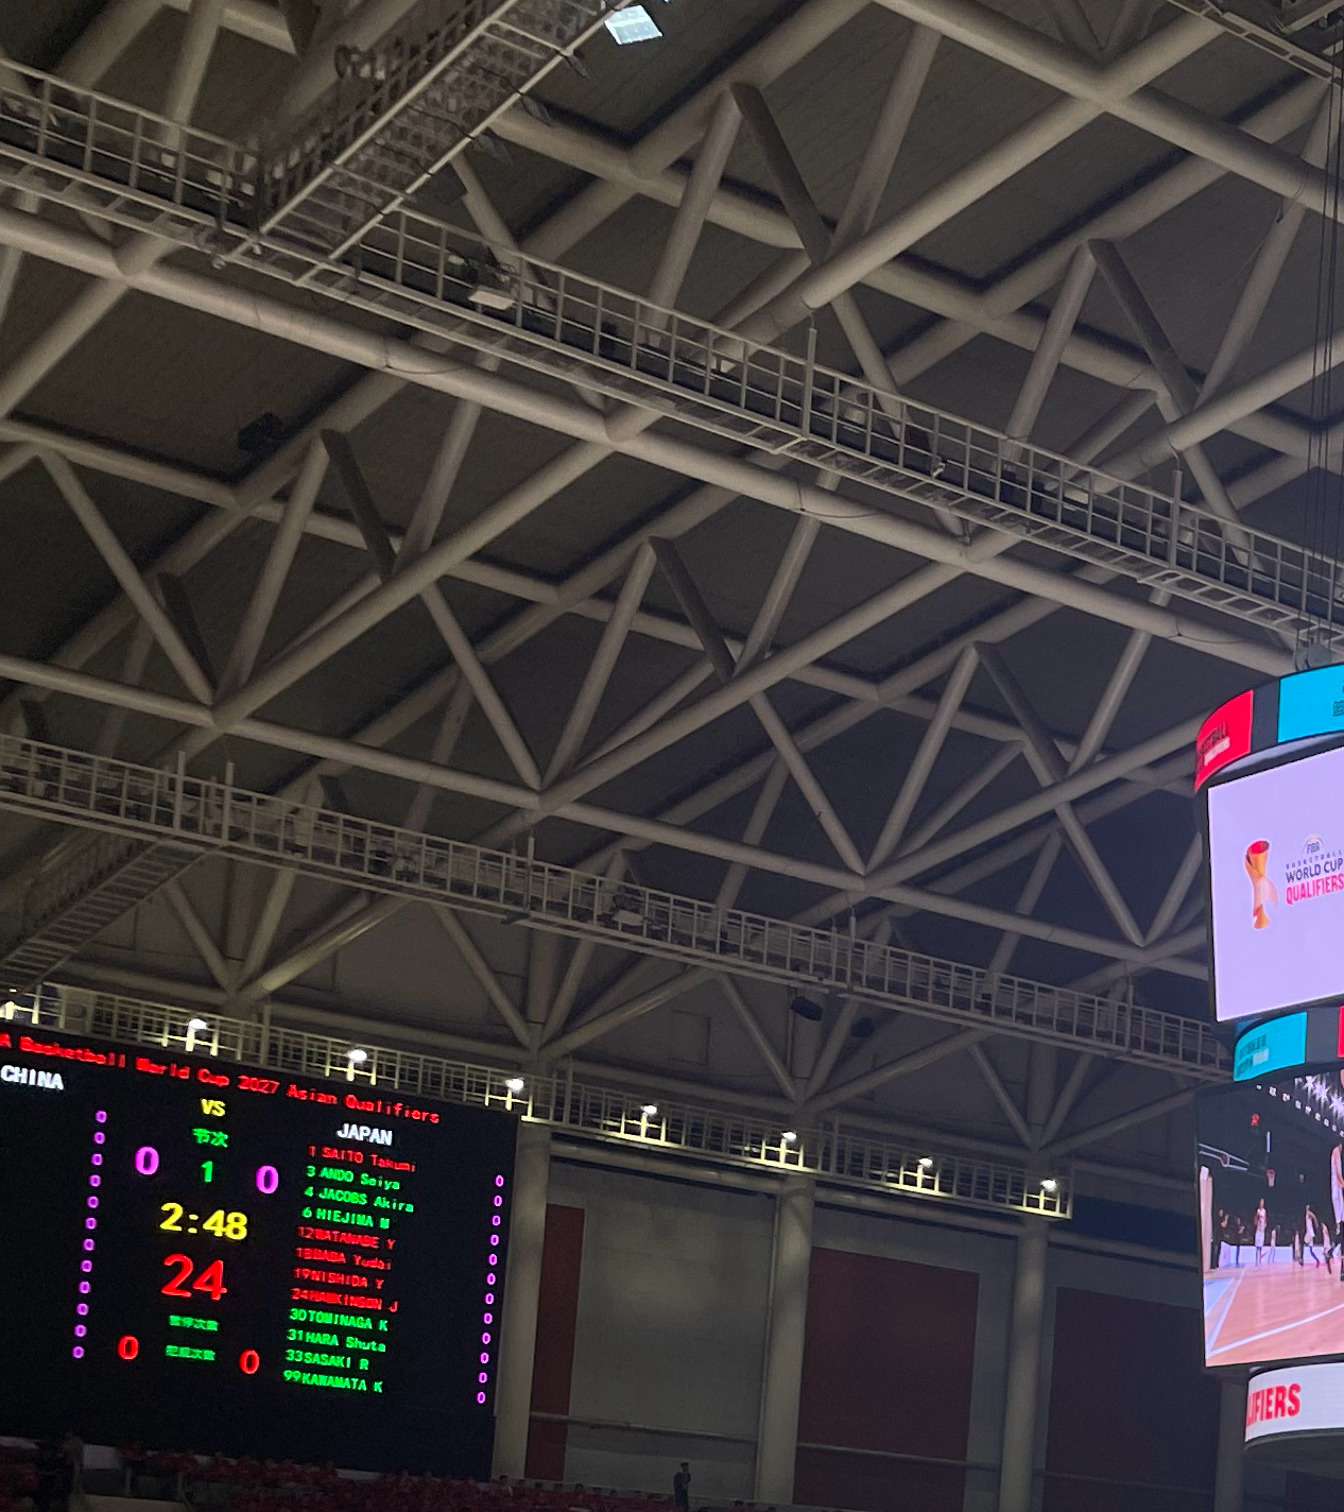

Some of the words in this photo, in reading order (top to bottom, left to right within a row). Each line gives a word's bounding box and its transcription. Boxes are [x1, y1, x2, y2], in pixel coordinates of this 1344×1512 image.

[1285, 863, 1321, 883] WORLD
[1324, 857, 1344, 873] CUP
[1286, 872, 1344, 905] QUALIFIERS
[1, 1064, 64, 1090] CHINA
[20, 1036, 126, 1068] Basketball
[136, 1056, 191, 1080] World
[198, 1068, 230, 1087] Cup
[237, 1075, 281, 1095] 2027
[286, 1083, 338, 1105] Asian
[345, 1094, 440, 1124] Qualifiers
[201, 1098, 226, 1117] VS
[336, 1123, 393, 1146] JAPAN
[135, 1146, 160, 1175] 0
[322, 1147, 364, 1165] SAITO
[202, 1161, 214, 1183] 1
[256, 1166, 279, 1194] 0
[306, 1165, 315, 1177] 3
[319, 1167, 354, 1183] ANDO
[360, 1173, 400, 1190] Seiya
[304, 1186, 314, 1198] 4
[318, 1187, 367, 1206] JACOBS
[373, 1196, 415, 1213] Akira
[160, 1202, 248, 1240] 2:48
[302, 1207, 312, 1219] 6
[161, 1253, 228, 1301] 24
[389, 1301, 399, 1313] J
[379, 1320, 389, 1332] K
[118, 1335, 139, 1360] 0
[346, 1336, 387, 1352] Shuta
[239, 1349, 260, 1374] 0
[360, 1358, 370, 1371] R
[374, 1381, 384, 1393] K
